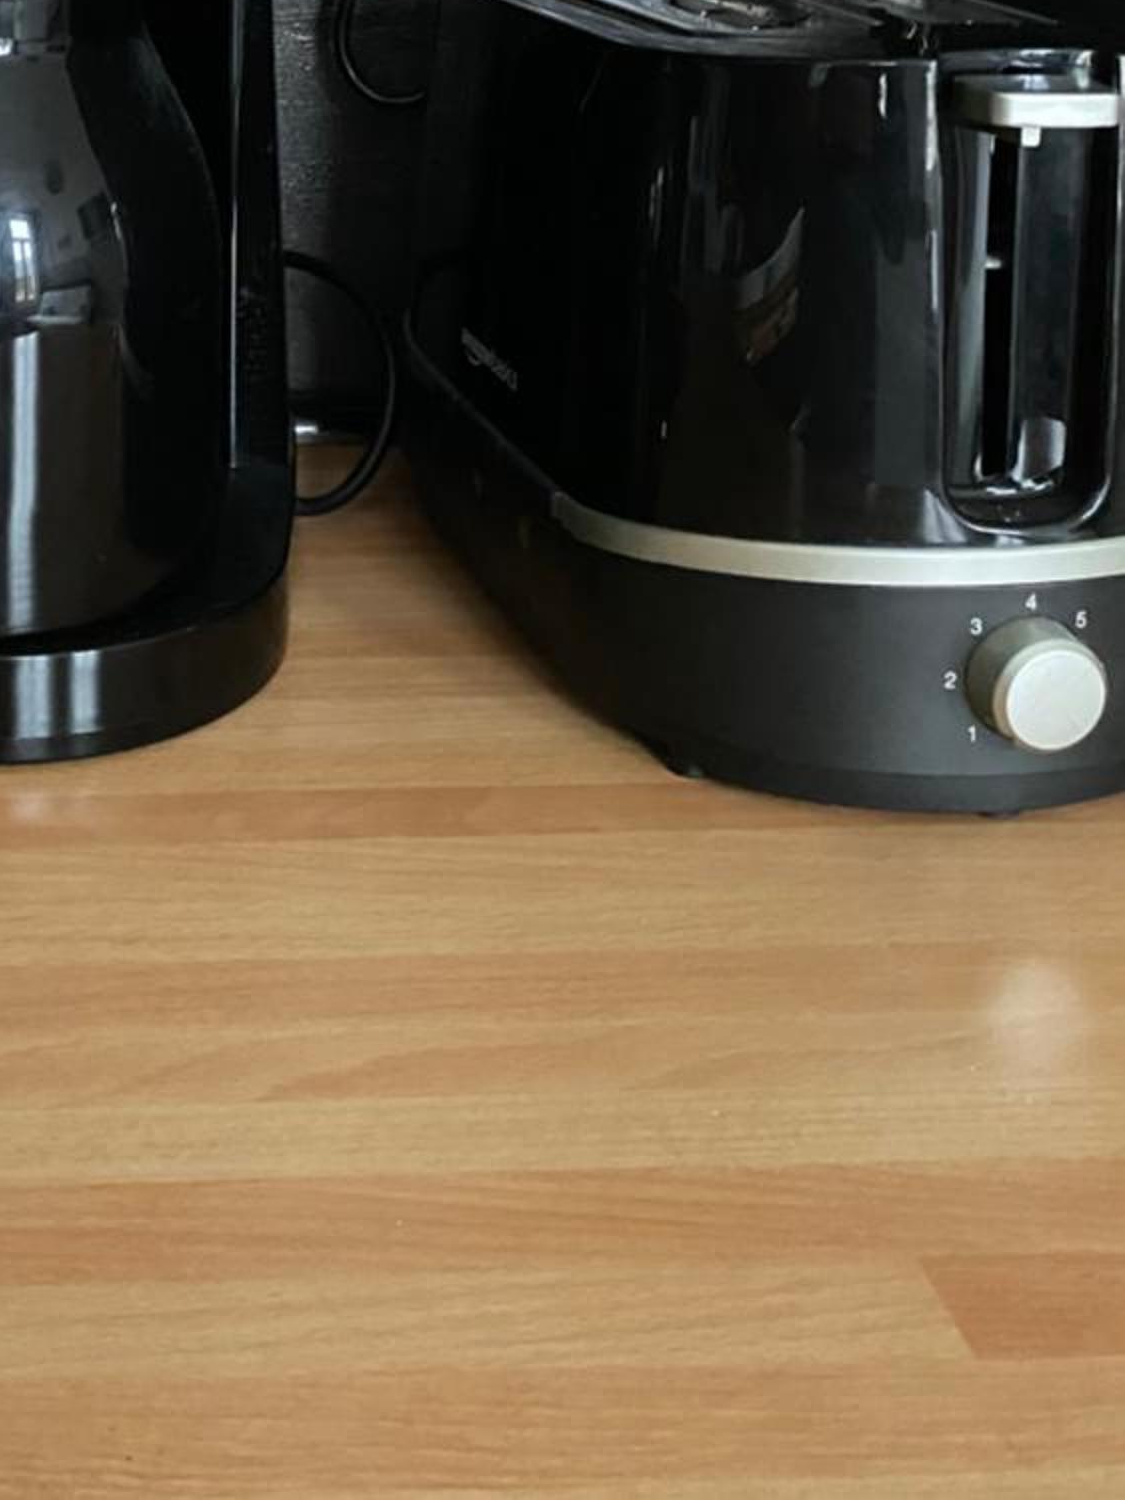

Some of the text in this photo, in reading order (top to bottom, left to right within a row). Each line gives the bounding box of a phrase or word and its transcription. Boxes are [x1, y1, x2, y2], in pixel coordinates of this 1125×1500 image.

[1025, 593, 1038, 611] 4
[970, 617, 983, 636] 3
[1075, 610, 1088, 629] 5
[943, 670, 958, 690] 2
[967, 724, 977, 742] 1
